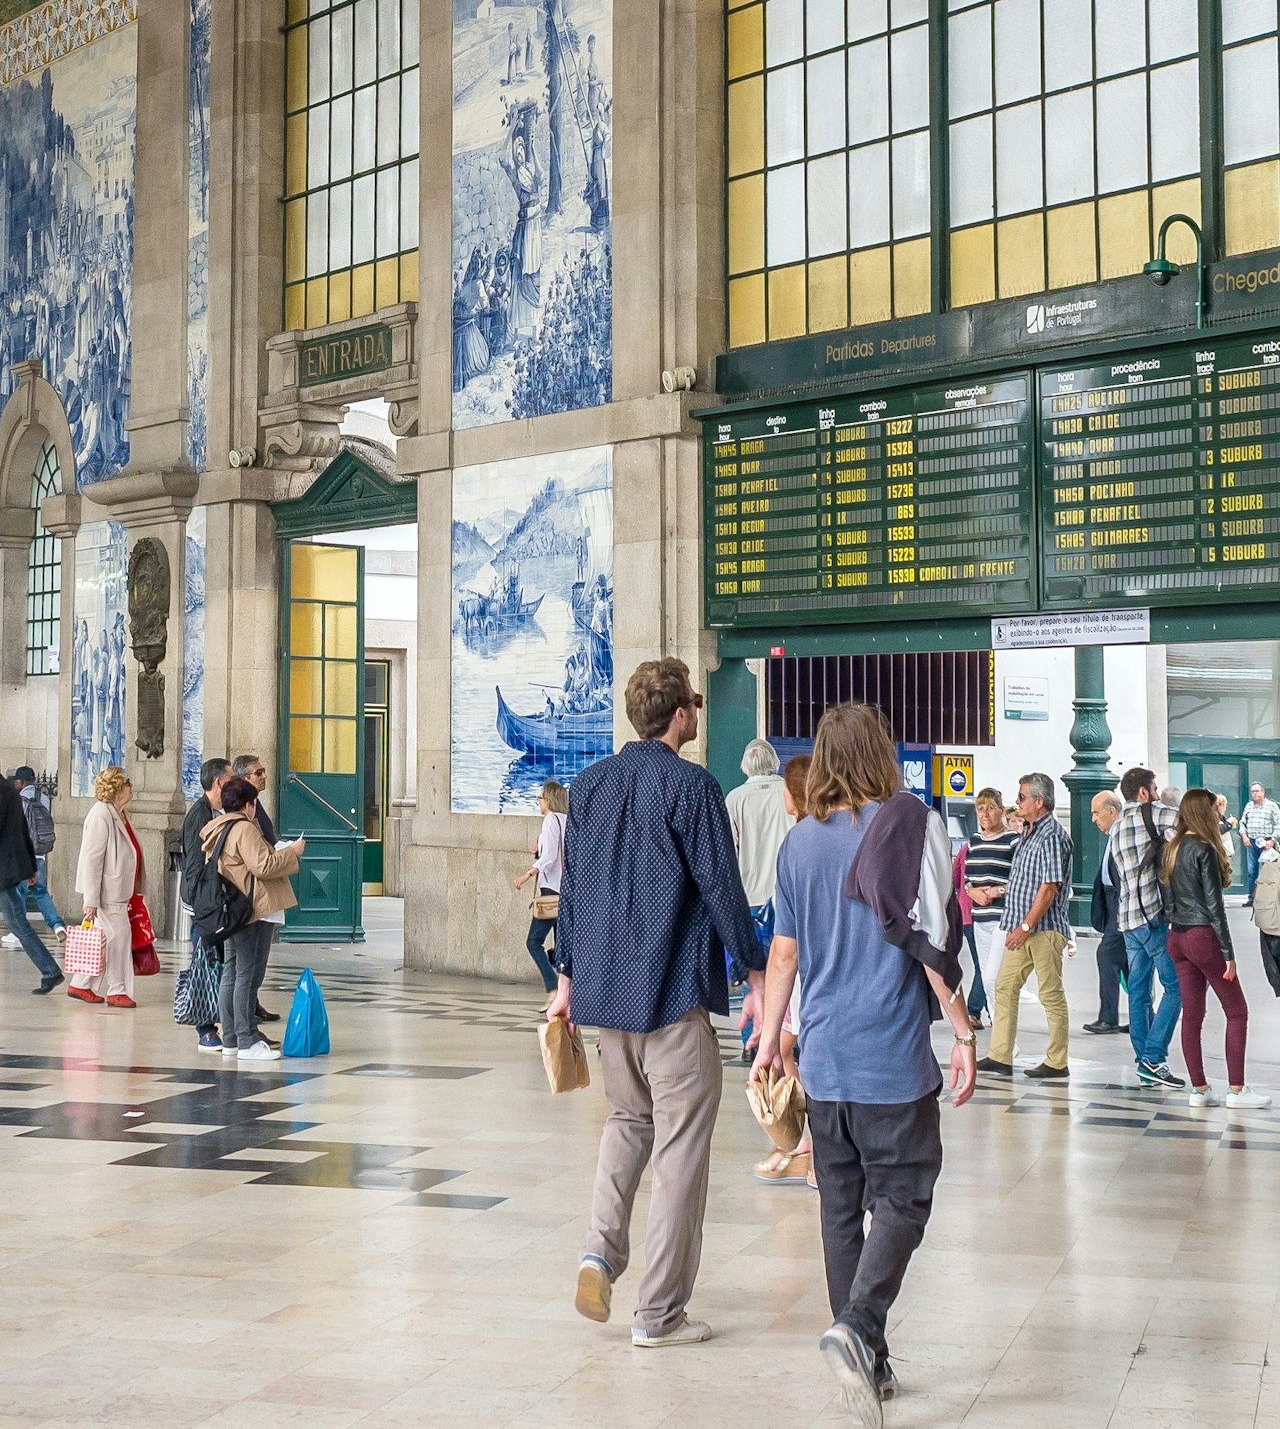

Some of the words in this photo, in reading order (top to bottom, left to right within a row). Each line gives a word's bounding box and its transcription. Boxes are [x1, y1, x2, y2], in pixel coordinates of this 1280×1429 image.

[1045, 299, 1097, 317] Infraestruturas
[1045, 318, 1054, 329] de
[1056, 312, 1082, 327] Portugal
[306, 330, 389, 378] ENTRADA
[825, 339, 874, 364] Partidas
[880, 333, 936, 355] Departures
[1057, 372, 1075, 382] hora
[1111, 359, 1161, 377] procedência
[1195, 351, 1215, 363] linha
[1058, 382, 1073, 392] hour
[1128, 373, 1144, 383] from
[1196, 363, 1214, 373] track
[1263, 353, 1280, 364] train
[1052, 395, 1082, 413] 14H25
[1088, 389, 1126, 408] AVEIRO
[1205, 377, 1213, 393] 5
[1218, 370, 1261, 391] SUBURB
[718, 424, 731, 433] hora
[766, 415, 787, 427] destino
[819, 409, 835, 420] linha
[859, 399, 887, 413] comboio
[944, 385, 988, 401] observações
[867, 412, 880, 421] train
[1052, 418, 1083, 436] 14H30
[1088, 413, 1120, 432] CAIDE
[1219, 394, 1261, 416] SUBURB
[715, 443, 737, 458] 14H45
[741, 440, 764, 455] BRAGA
[835, 426, 866, 443] SUBURB
[886, 420, 913, 437] 15227
[1089, 437, 1115, 454] OVAR
[1206, 426, 1213, 441] 2
[1220, 419, 1262, 440] SUBURB
[741, 460, 760, 475] OVAR
[835, 446, 866, 464] SUBURB
[1089, 460, 1121, 477] BRAGA
[1206, 450, 1214, 466] 3
[1220, 444, 1262, 464] SUBURB
[741, 478, 778, 495] PENAFIEL
[836, 467, 867, 484] SUBURB
[887, 462, 914, 478] 15413
[1053, 487, 1084, 504] 14H50
[1089, 482, 1135, 501] POCINHO
[1221, 472, 1236, 489] IR
[715, 502, 737, 517] 15H05
[741, 499, 769, 515] AVEIRO
[836, 488, 867, 505] SUBURB
[887, 483, 914, 500] 15736
[1054, 509, 1085, 526] 15H00
[1090, 504, 1141, 523] PENAFIEL
[1207, 498, 1215, 514] 2
[1221, 494, 1263, 513] SUBURB
[715, 522, 737, 537] 15H10
[741, 519, 765, 534] REGUA
[837, 511, 847, 525] IR
[897, 504, 915, 520] 869
[1055, 532, 1085, 549] 15H05
[1090, 527, 1149, 546] GUIMARAES
[1207, 523, 1215, 538] 4
[1221, 518, 1264, 537] SUBURB
[715, 541, 737, 556] 15H30
[741, 539, 765, 554] CAIDE
[836, 530, 867, 546] SUBURB
[887, 525, 915, 541] 15533
[1091, 553, 1117, 570] OVAR
[1208, 546, 1216, 562] 5
[1222, 543, 1265, 562] SUBURB
[741, 559, 765, 574] BRAGA
[837, 550, 867, 567] SUBURB
[888, 547, 915, 563] 15229
[715, 581, 738, 595] 15H50
[742, 579, 761, 594] OVAR
[837, 571, 868, 588] SUBURB
[919, 565, 958, 581] COMBOIO
[963, 563, 975, 579] DA
[979, 560, 1015, 578] FRENTE
[1009, 619, 1019, 627] Por
[1039, 617, 1062, 628] prepare
[1070, 615, 1081, 624] seu
[1083, 612, 1100, 623] título
[1101, 612, 1110, 622] de
[1010, 628, 1040, 638] exibindo-o
[1041, 627, 1051, 636] aos
[1051, 626, 1074, 637] agentes
[1074, 624, 1082, 634] de
[1083, 622, 1117, 634] fiscalização
[945, 757, 971, 768] ATM
